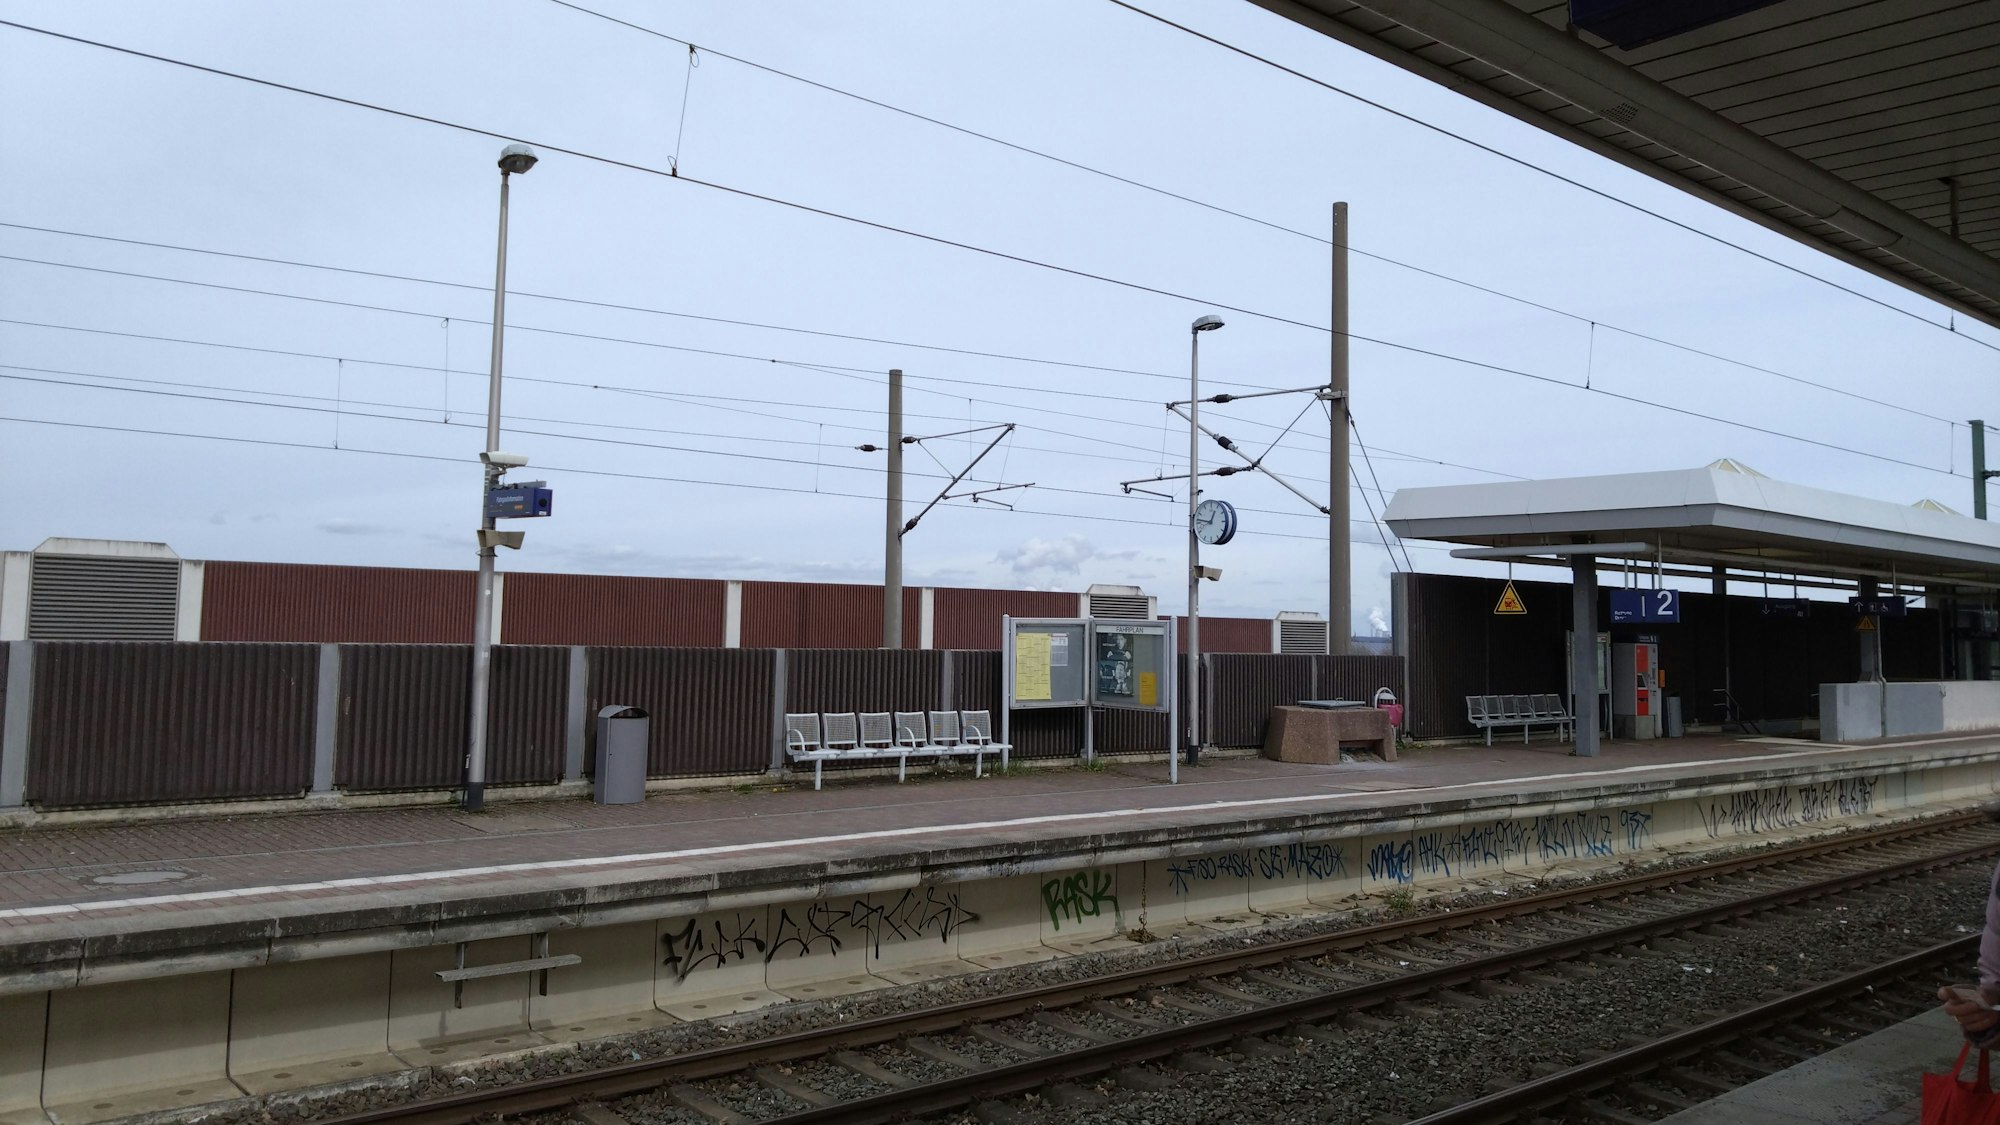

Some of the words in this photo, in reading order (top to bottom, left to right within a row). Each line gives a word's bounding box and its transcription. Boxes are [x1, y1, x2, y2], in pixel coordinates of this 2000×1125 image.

[1657, 590, 1674, 616] 2
[1116, 626, 1144, 634] FAHRPLAN
[1042, 870, 1122, 932] RASK
